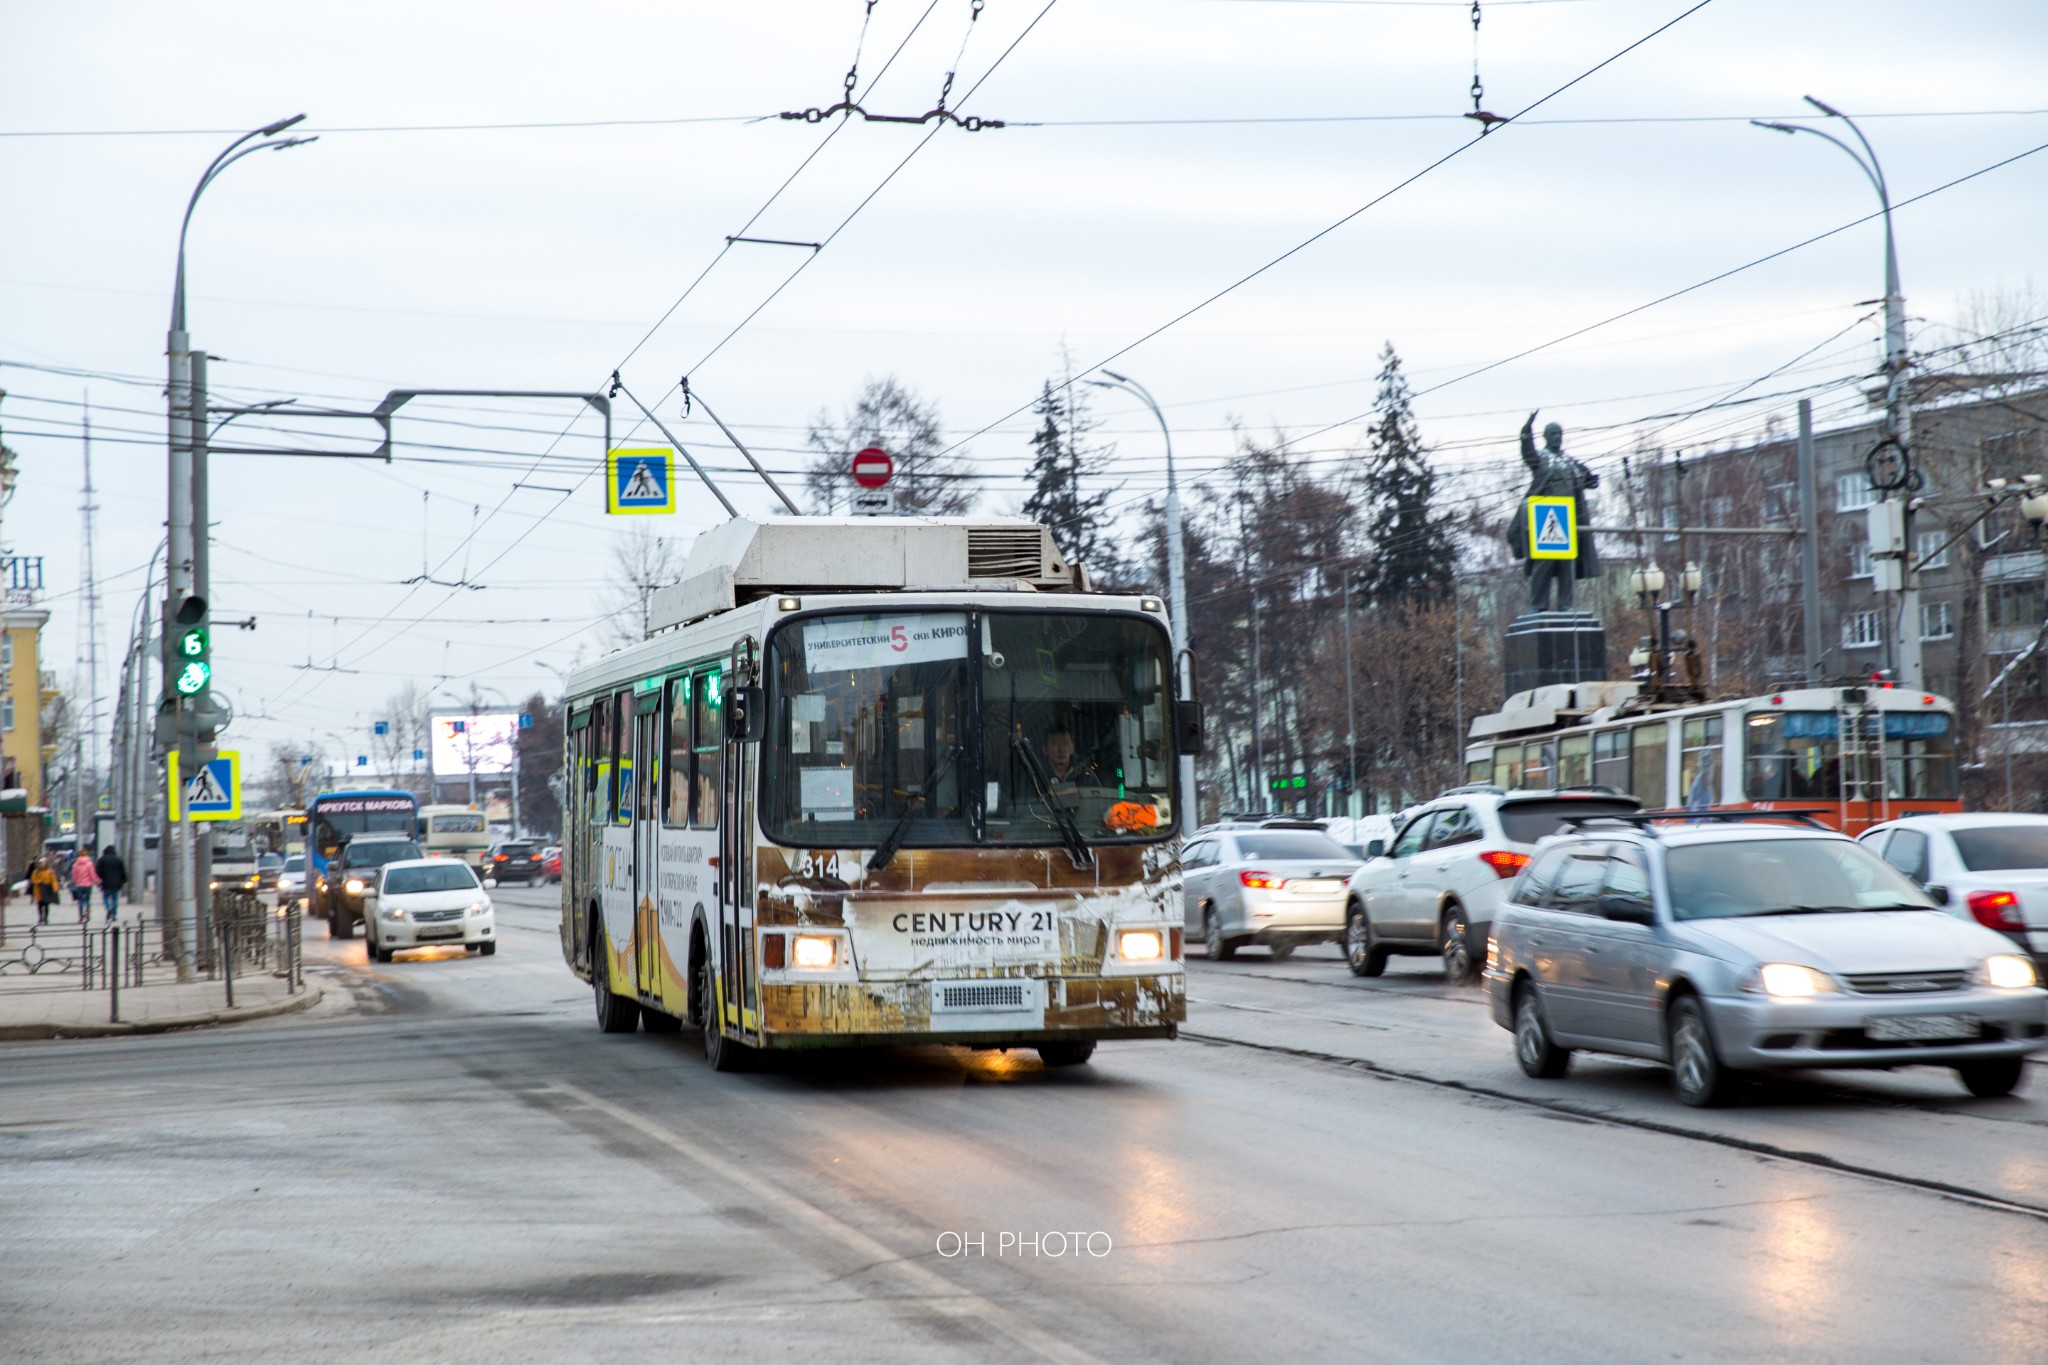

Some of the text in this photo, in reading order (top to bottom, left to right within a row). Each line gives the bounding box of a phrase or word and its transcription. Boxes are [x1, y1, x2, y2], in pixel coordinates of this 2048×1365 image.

[891, 625, 908, 652] 5
[317, 802, 363, 813] ИРКУТСК
[803, 855, 839, 879] 314
[893, 912, 1053, 933] CENTURY 21
[911, 934, 1040, 948] недвижимость мира
